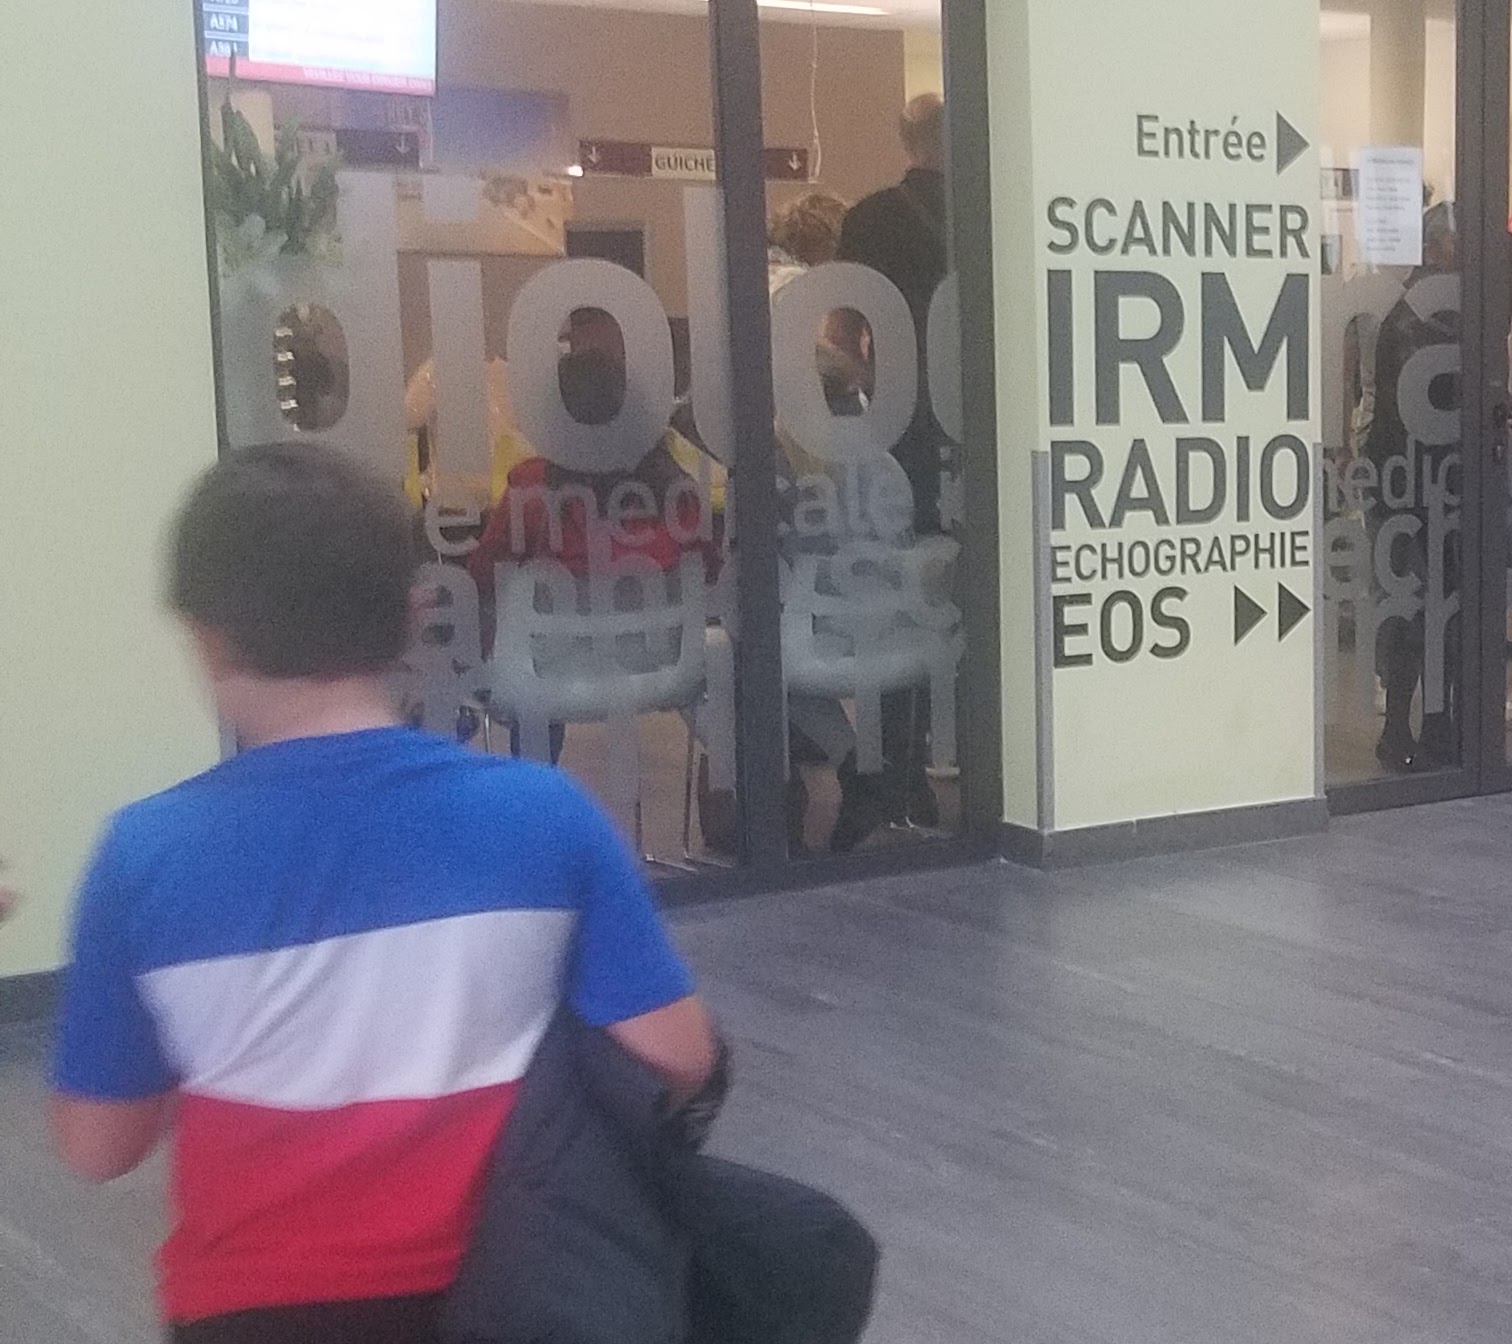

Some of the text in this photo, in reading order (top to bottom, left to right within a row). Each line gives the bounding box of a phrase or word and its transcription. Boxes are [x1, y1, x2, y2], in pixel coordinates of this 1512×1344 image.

[1136, 113, 1267, 160] Entrée
[1046, 197, 1311, 259] SCANNER
[1046, 269, 1311, 427] IRM
[1051, 433, 1311, 531] RADIO
[1051, 530, 1311, 585] ECHOGRAPHIE
[1052, 585, 1191, 669] EOS
